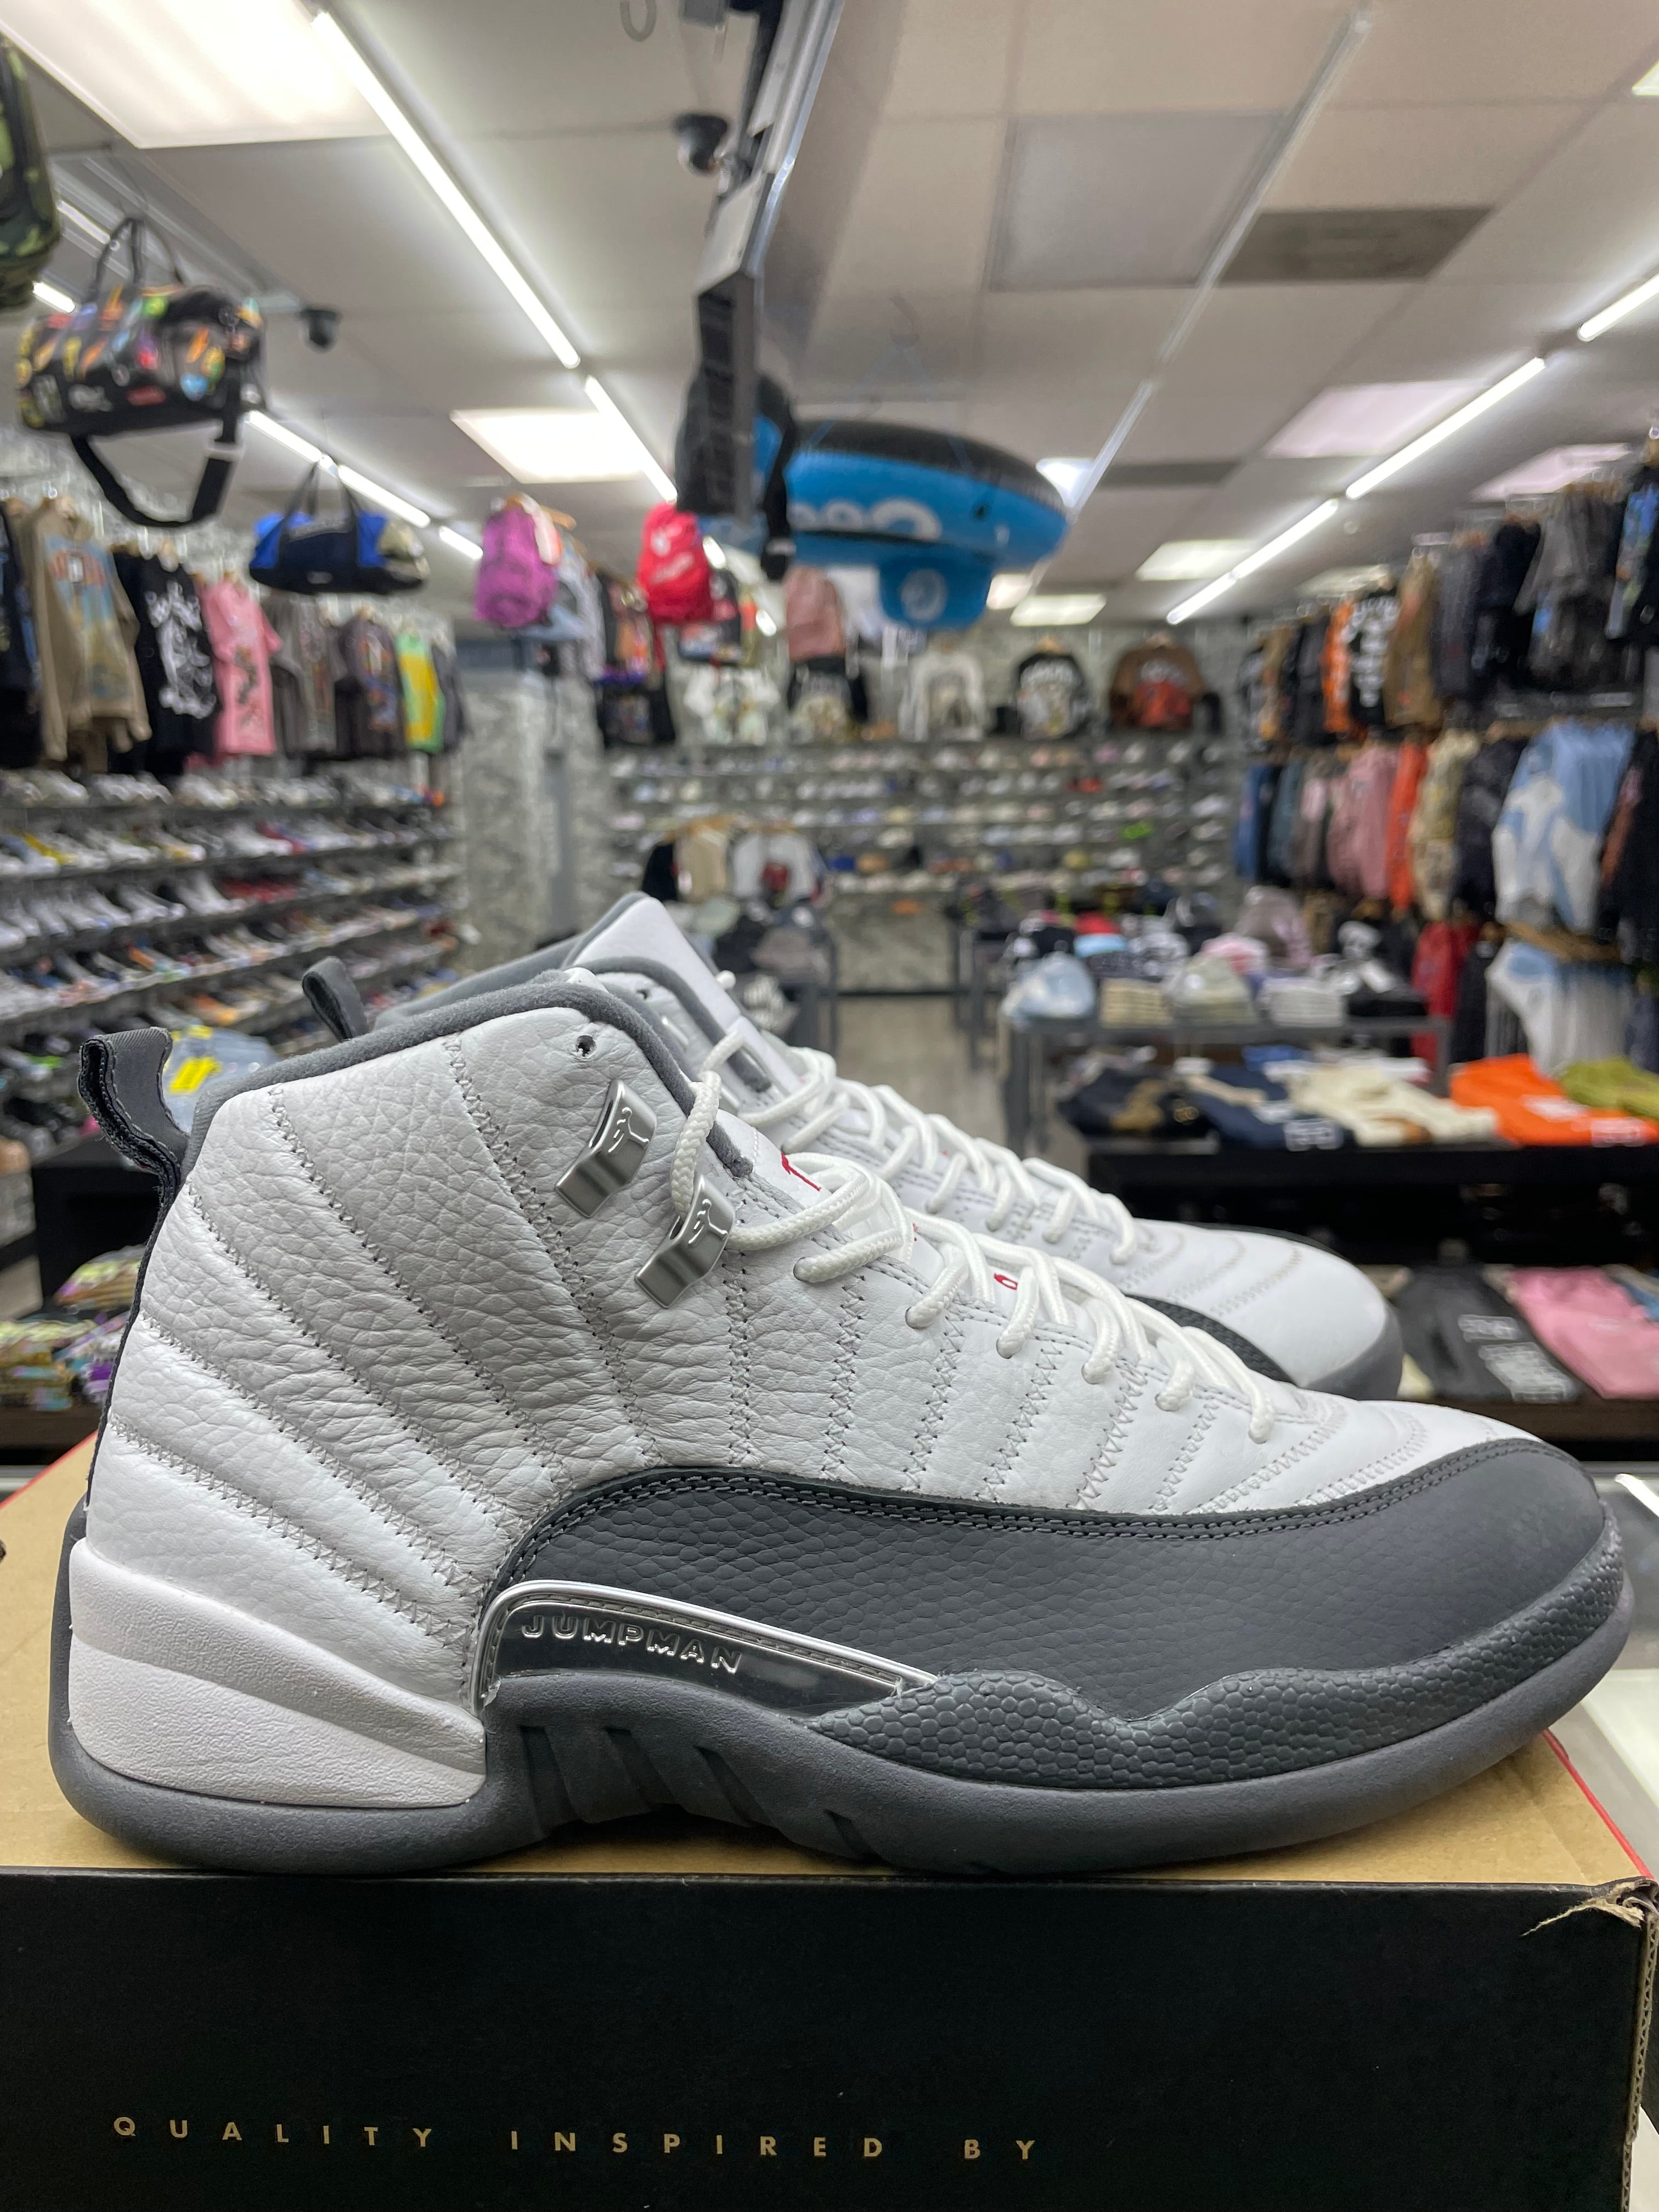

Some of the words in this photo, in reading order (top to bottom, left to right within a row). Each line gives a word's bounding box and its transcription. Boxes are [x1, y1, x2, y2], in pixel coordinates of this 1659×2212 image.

[521, 1615, 742, 1674] JUMPMAN
[113, 2116, 432, 2148] QUALITY
[511, 2130, 883, 2158] INSPIRED
[963, 2138, 1036, 2160] BY
